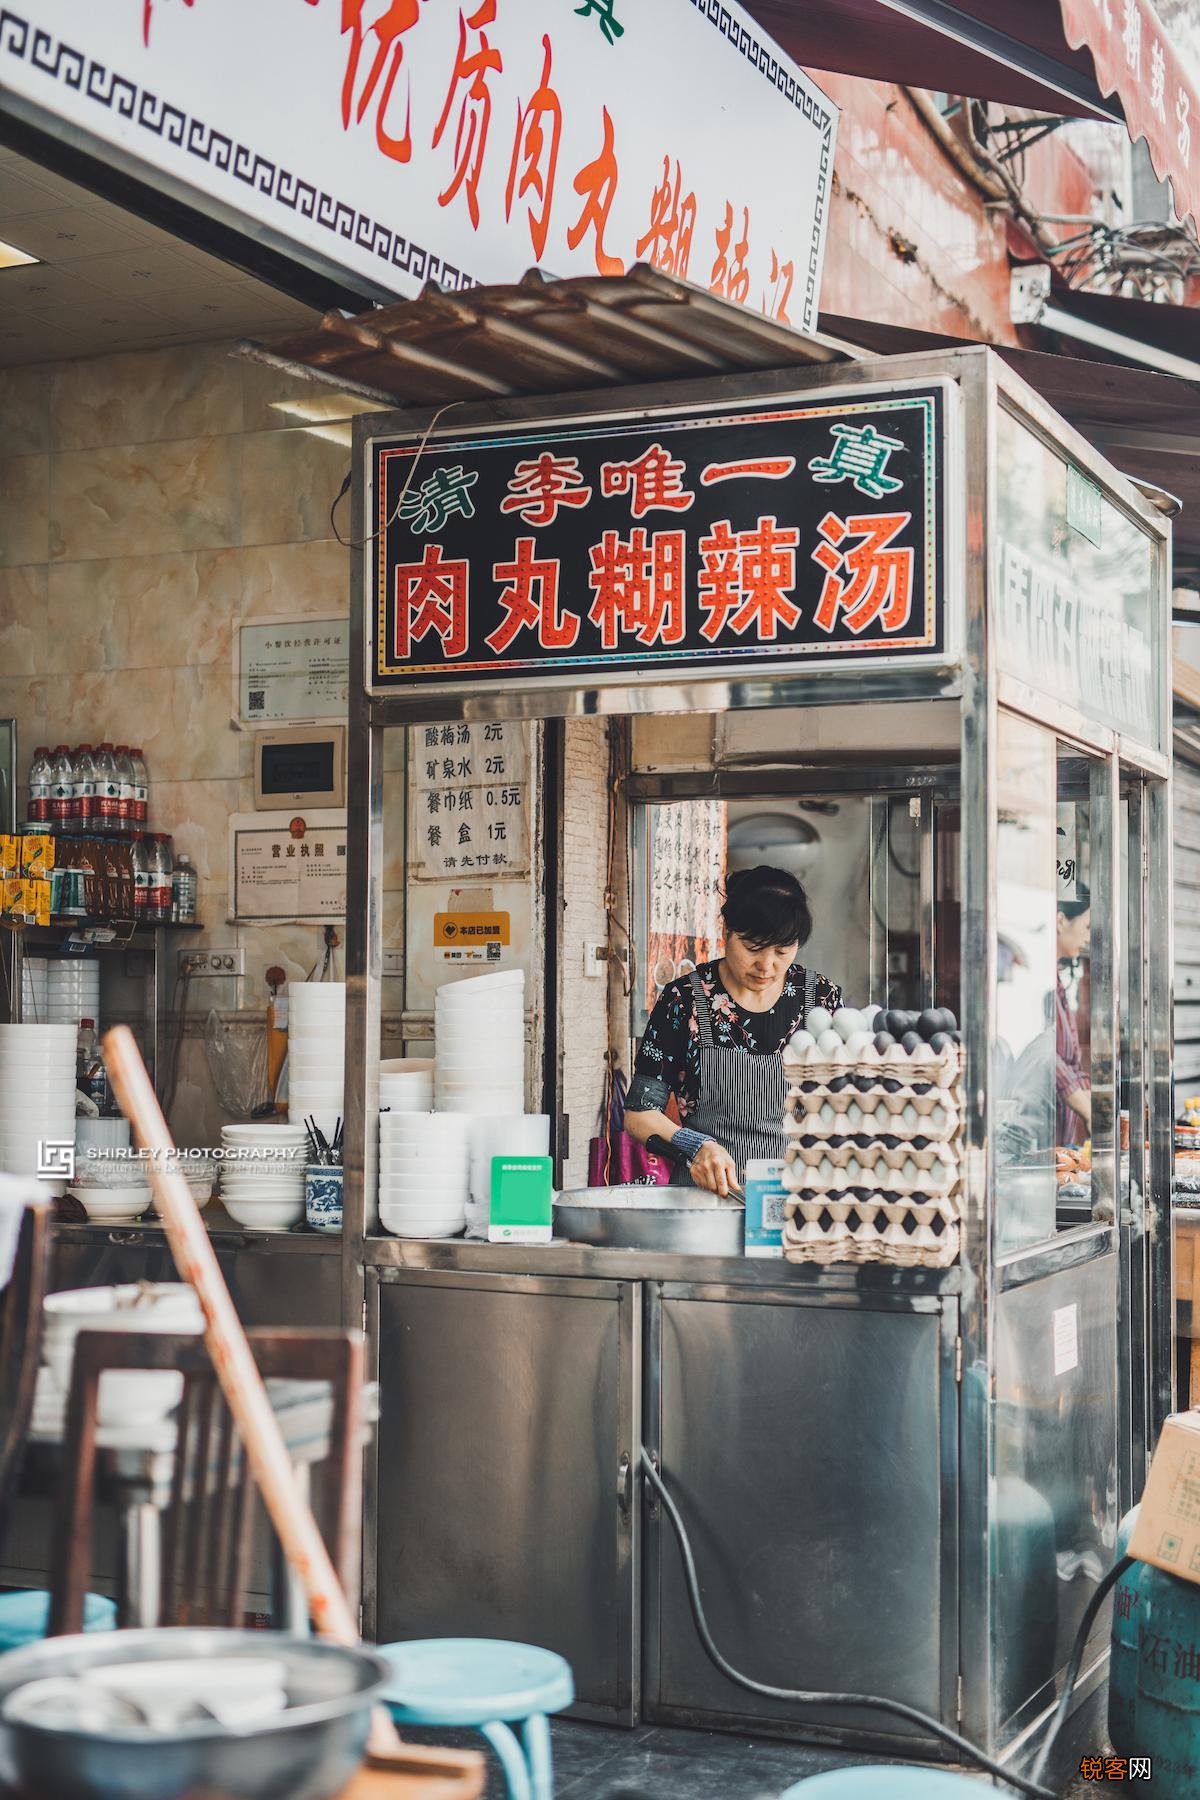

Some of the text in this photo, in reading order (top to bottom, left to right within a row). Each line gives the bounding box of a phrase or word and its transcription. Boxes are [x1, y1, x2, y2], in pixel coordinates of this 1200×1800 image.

[394, 511, 914, 659] 肉丸糊辣汤
[425, 723, 503, 747] 酸梅汤 2元
[426, 756, 505, 780] 矿泉水 2元
[427, 788, 521, 814] 餐巾纸 0.5元
[487, 822, 507, 840] 1元
[271, 843, 324, 858] 营业执照
[443, 853, 508, 868] 请先付款
[460, 925, 500, 935] 本店已加盟
